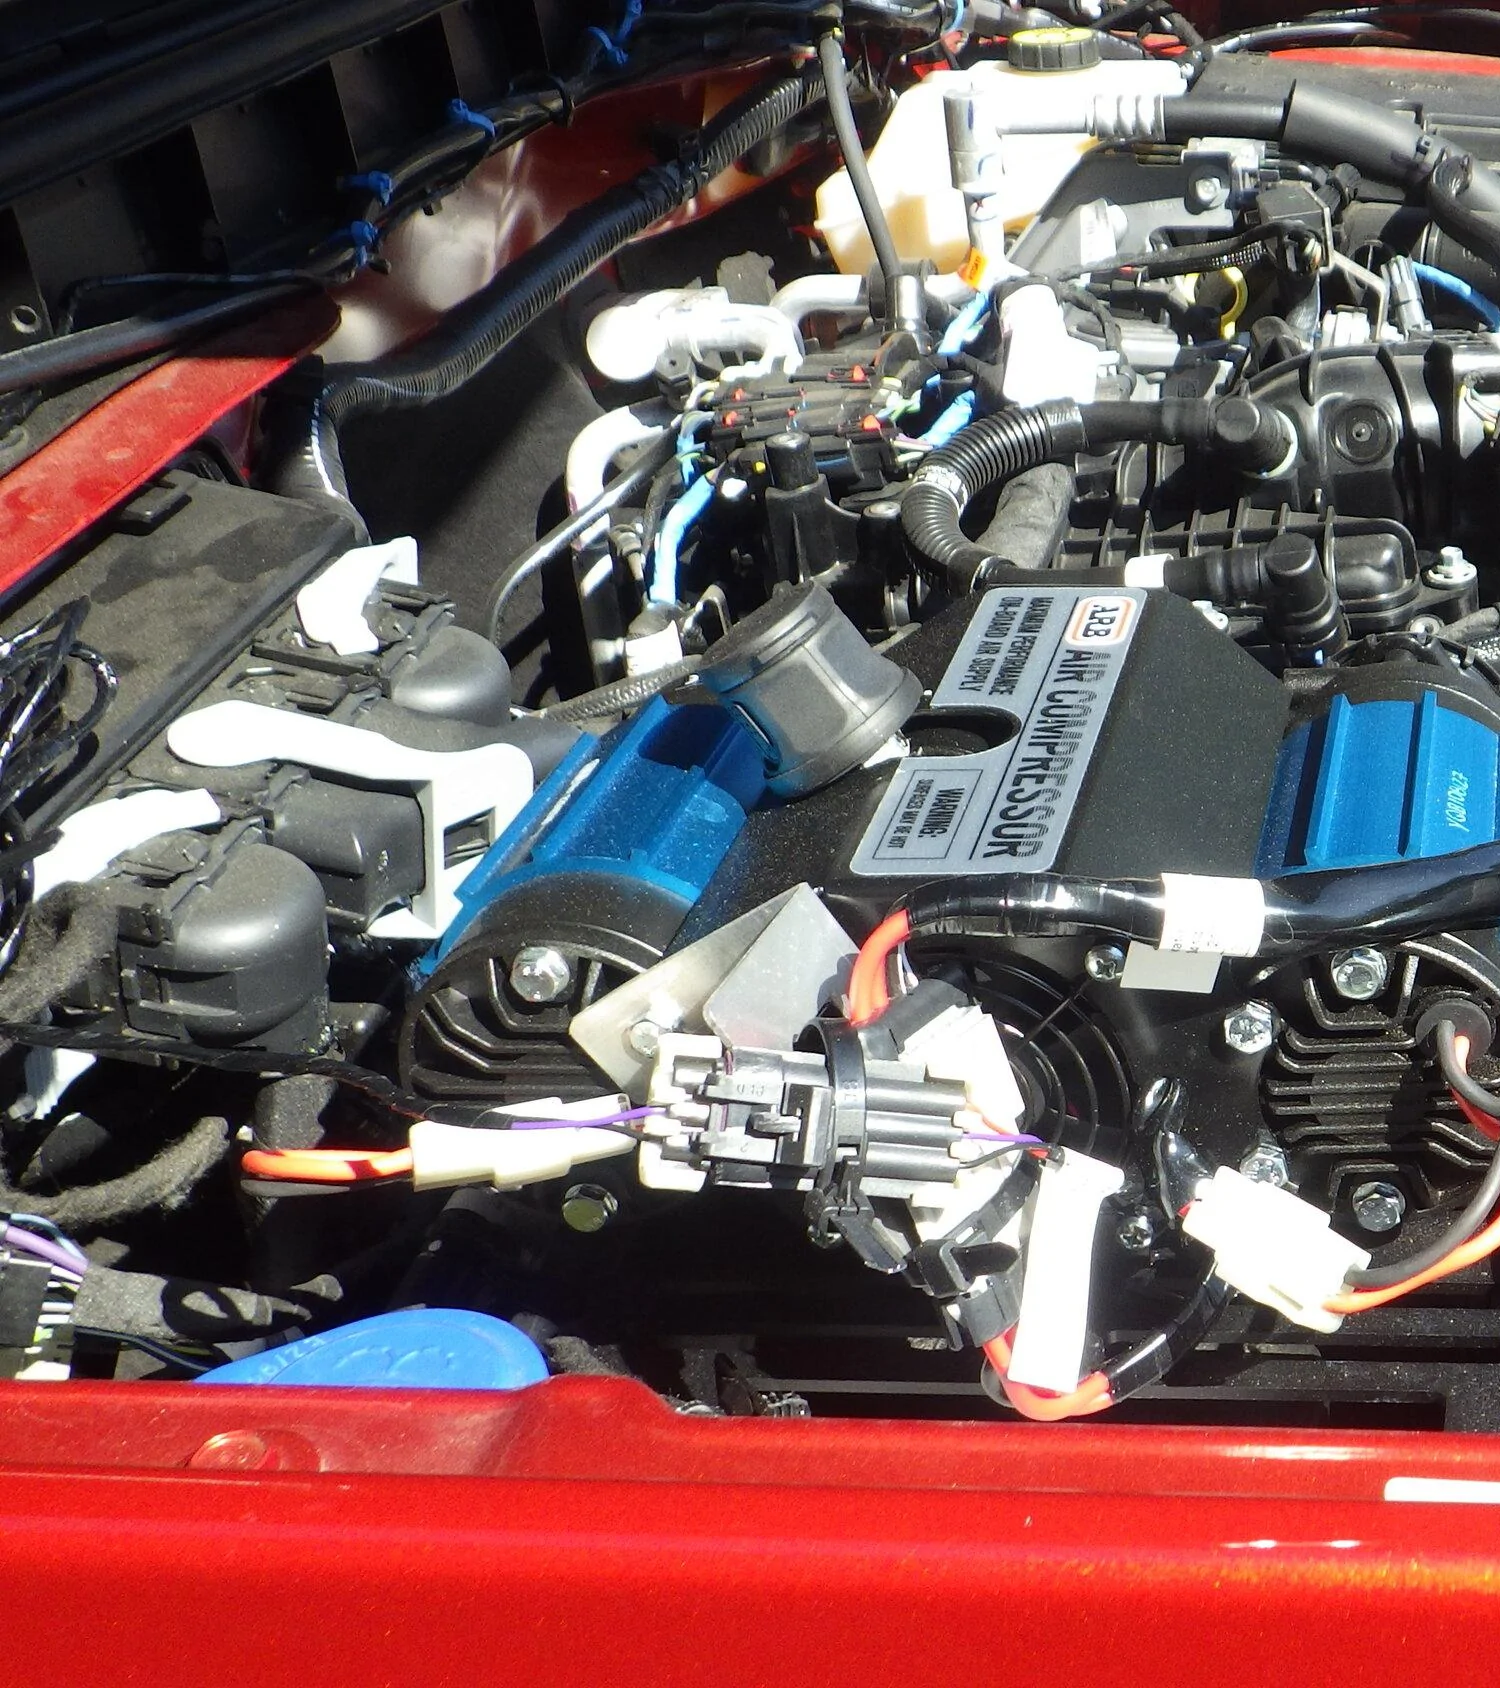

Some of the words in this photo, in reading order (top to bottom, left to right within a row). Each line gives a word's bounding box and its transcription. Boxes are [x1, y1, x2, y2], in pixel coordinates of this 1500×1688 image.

[984, 596, 1024, 638] ON-BOARD
[1017, 596, 1055, 633] MAXIMUM
[1082, 603, 1120, 638] ARB
[975, 640, 1003, 655] AIR
[988, 634, 1038, 696] PERFORMANCE
[958, 657, 996, 692] SUPPLY
[1053, 649, 1112, 683] AIR
[983, 689, 1098, 859] COMPRESSOR
[906, 779, 934, 809] SURFACES
[899, 810, 919, 825] MAY
[918, 787, 965, 838] WARNING:
[887, 835, 909, 849] HOT
[893, 826, 912, 835] BE
